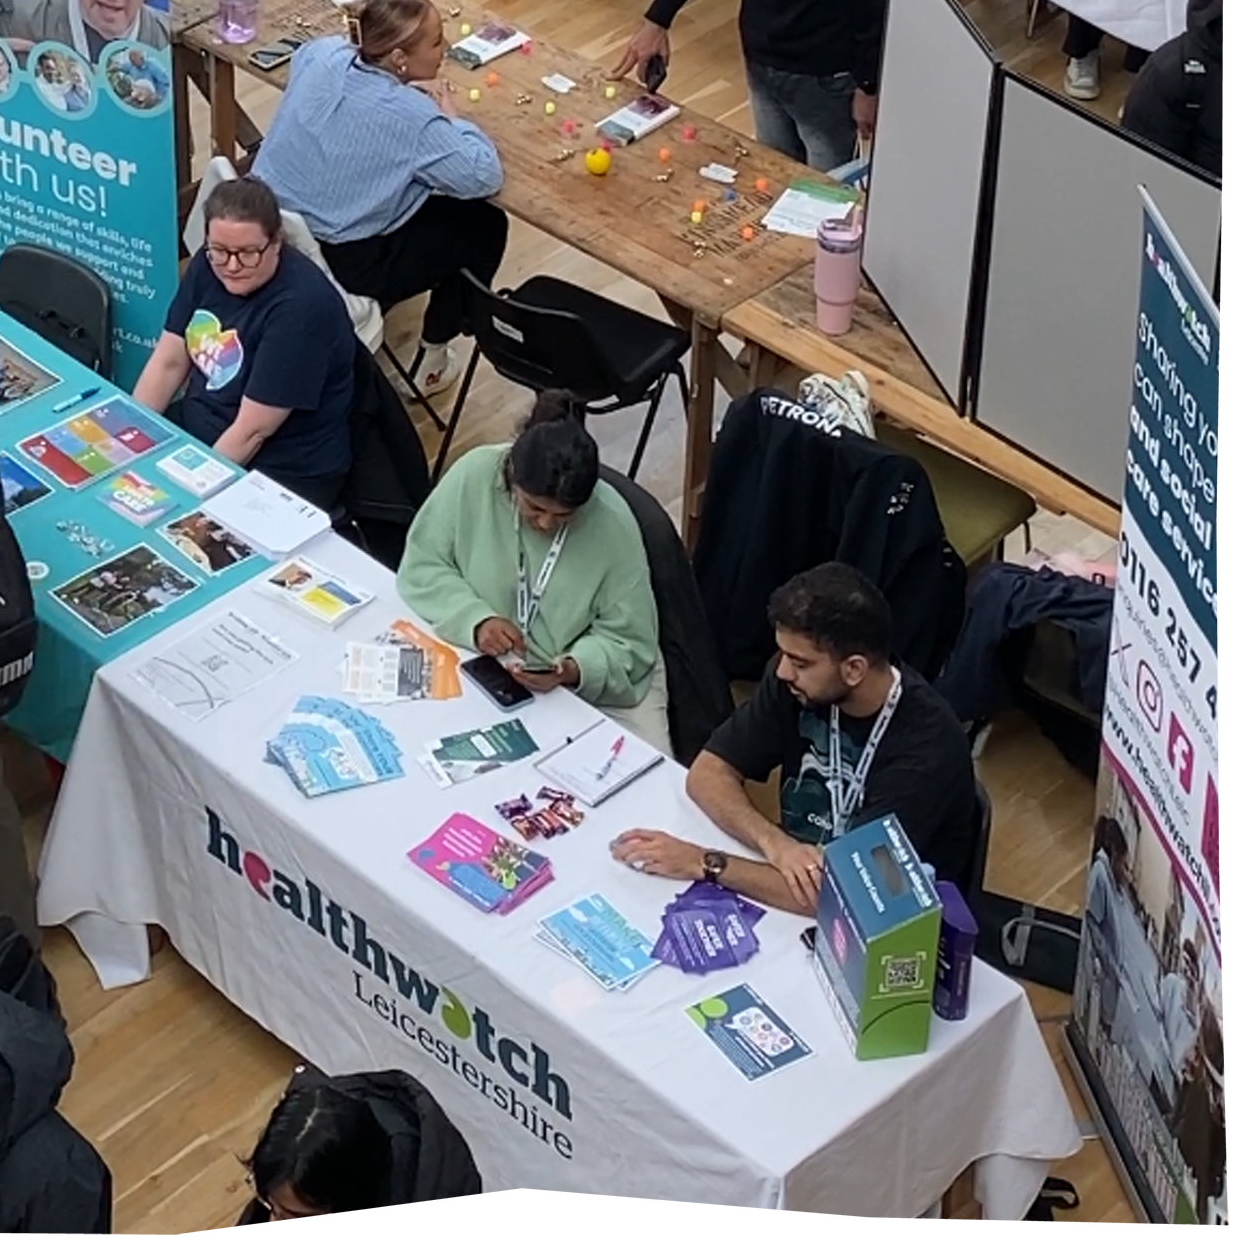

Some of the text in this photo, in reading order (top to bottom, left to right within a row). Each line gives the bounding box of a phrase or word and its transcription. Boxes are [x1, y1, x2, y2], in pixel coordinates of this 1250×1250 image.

[4, 187, 34, 213] bring
[36, 204, 44, 214] a
[46, 208, 79, 230] range
[82, 217, 95, 232] of
[96, 223, 129, 248] skills,
[131, 237, 152, 252] life
[13, 207, 74, 240] dedication
[75, 230, 100, 250] that
[102, 239, 153, 268] enriches
[51, 172, 106, 217] us!
[14, 222, 52, 247] people
[54, 237, 73, 252] we
[74, 243, 119, 271] support
[121, 260, 145, 280] and
[126, 278, 156, 300] truly
[1138, 311, 1199, 428] Sharing
[1128, 405, 1212, 551] and social
[1133, 360, 1163, 414] can
[1162, 412, 1215, 502] shape
[1126, 449, 1159, 518] care
[1161, 509, 1228, 638] services
[1166, 602, 1204, 683] 257
[205, 805, 572, 1121] healthwatch
[352, 971, 573, 1159] Leicestershire
